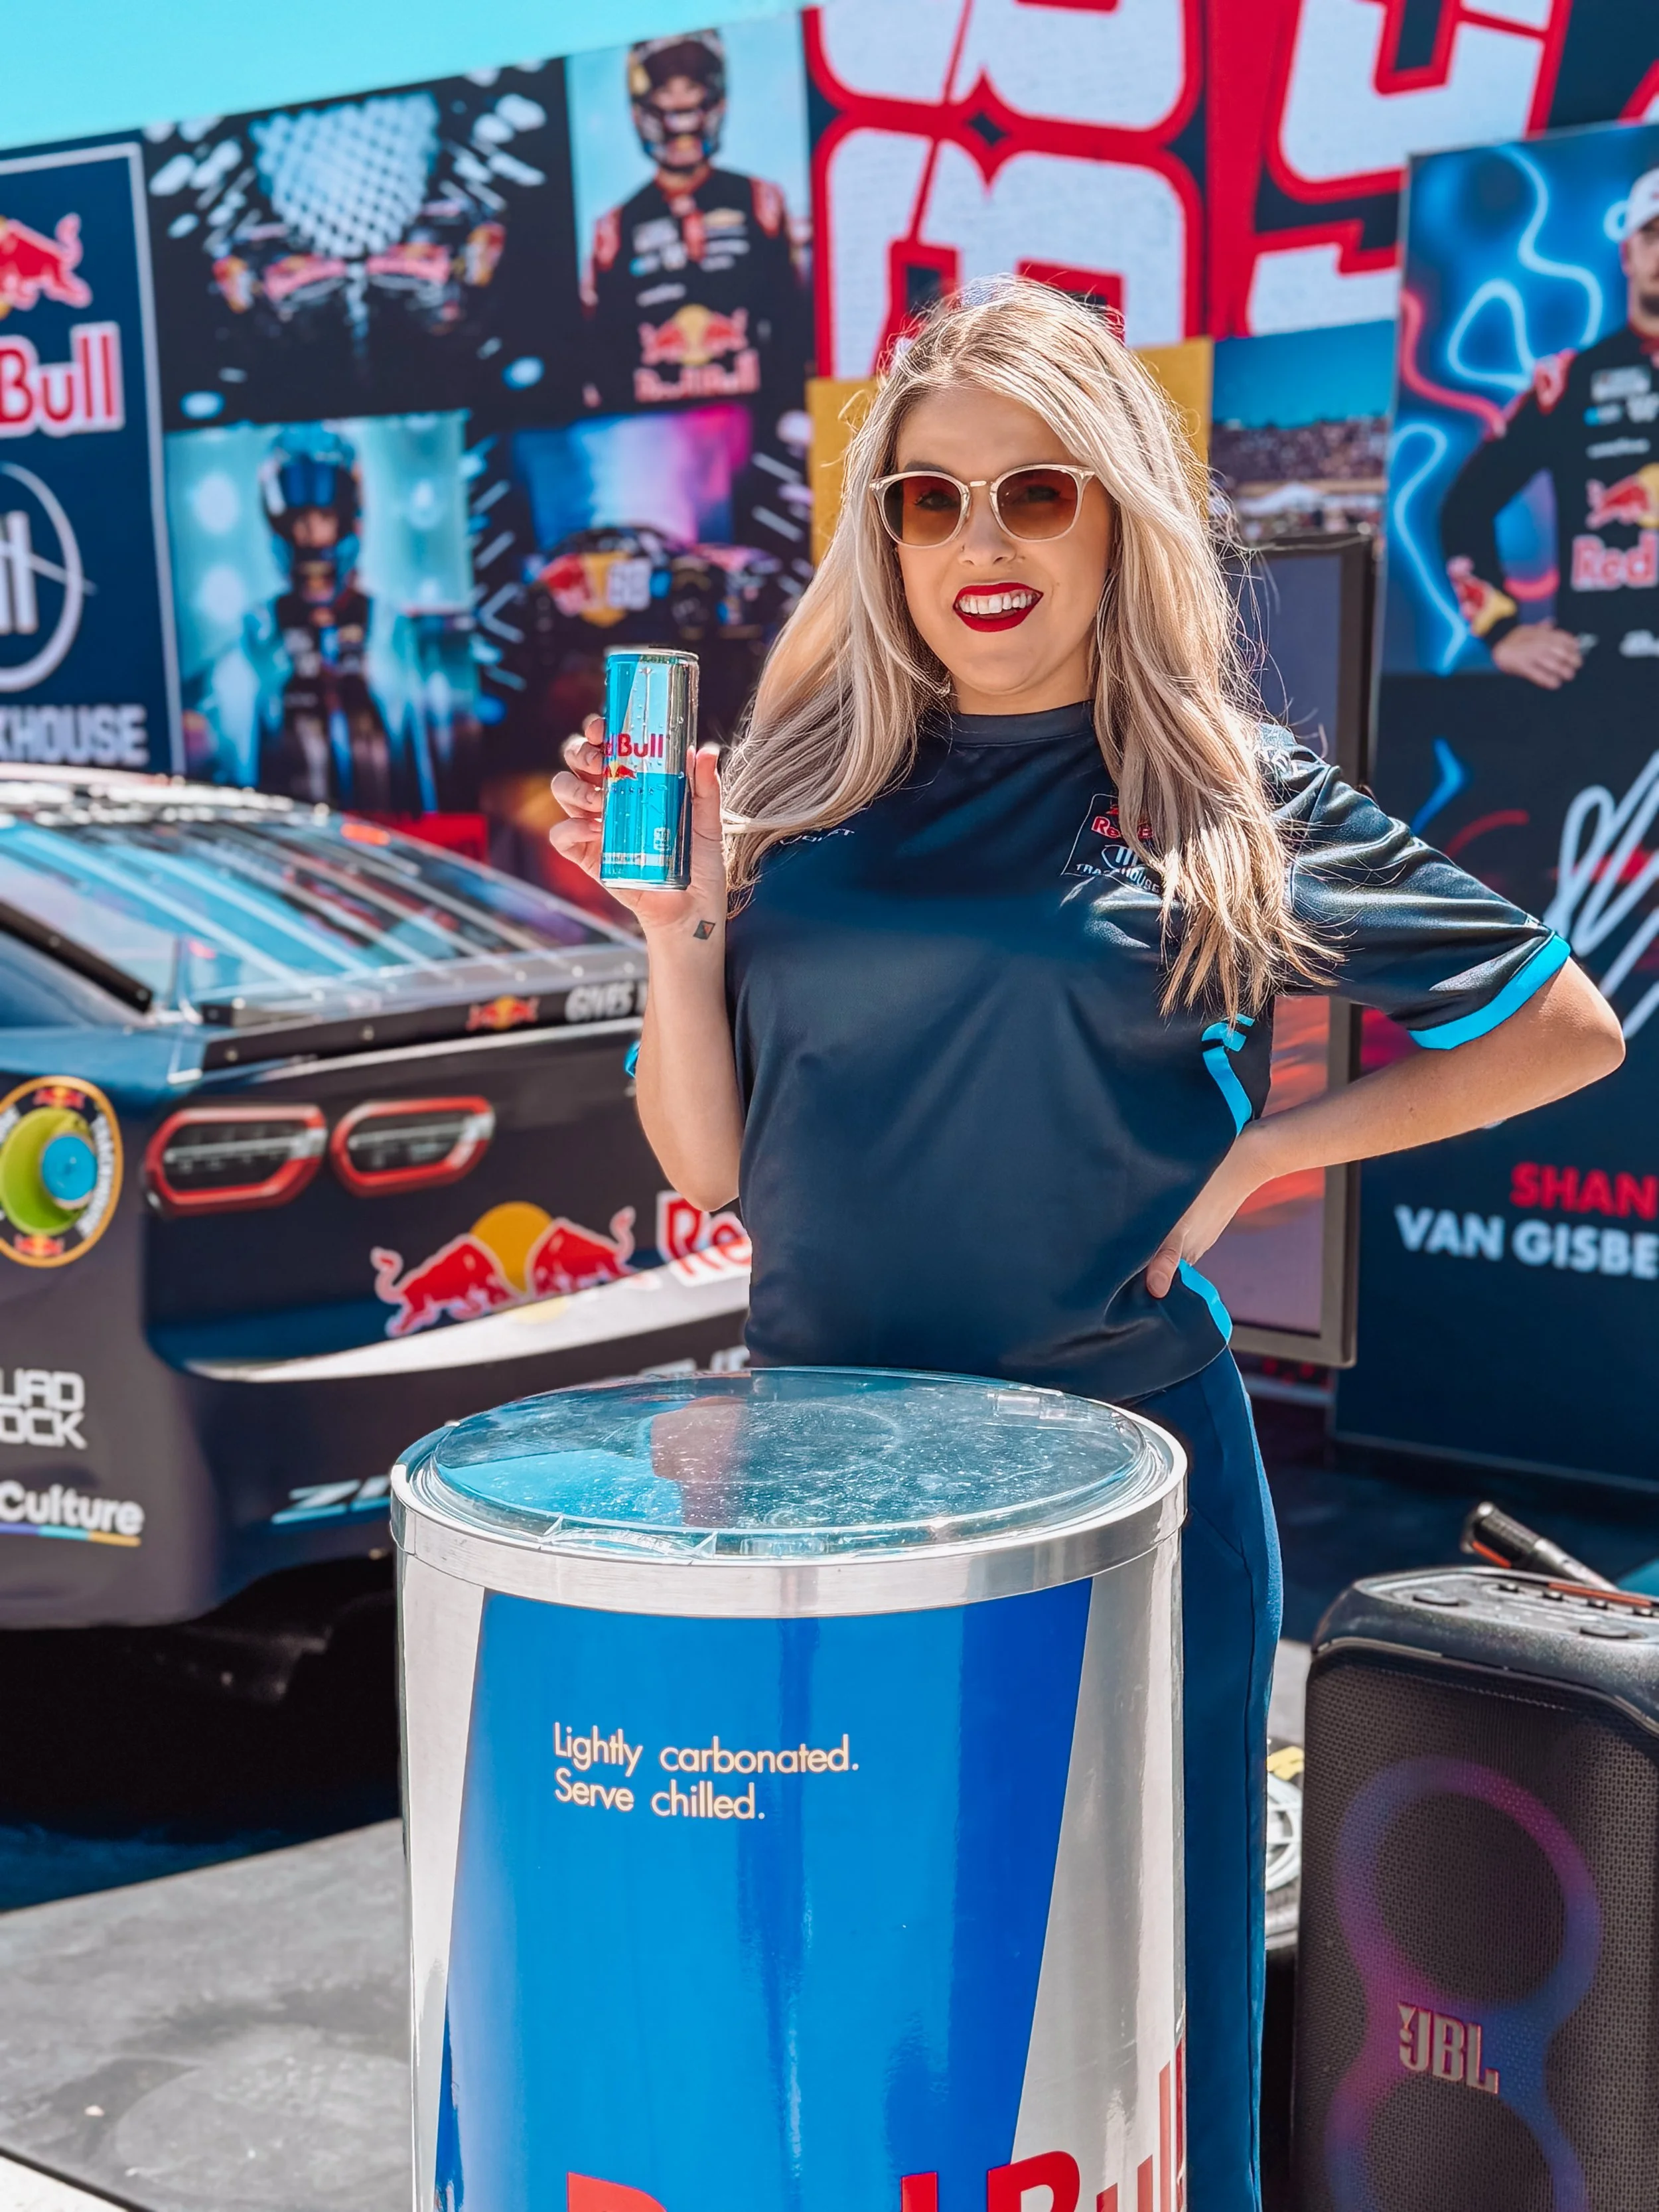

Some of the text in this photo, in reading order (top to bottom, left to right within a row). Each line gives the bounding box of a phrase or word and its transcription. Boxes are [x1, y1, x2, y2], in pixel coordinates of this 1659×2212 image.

[0, 325, 121, 435] Bull
[1571, 532, 1657, 591] Red
[618, 733, 664, 758] Bull
[1091, 816, 1122, 839] Re
[1076, 863, 1160, 893] TRAHOUSE
[1509, 1161, 1659, 1220] SHAN
[1394, 1204, 1659, 1281] VAN GISBE
[0, 1479, 145, 1536] Culture
[553, 1722, 859, 1777] Lightly carbonated.
[554, 1767, 766, 1820] Serve chilled.
[1398, 2000, 1499, 2095] JBL
